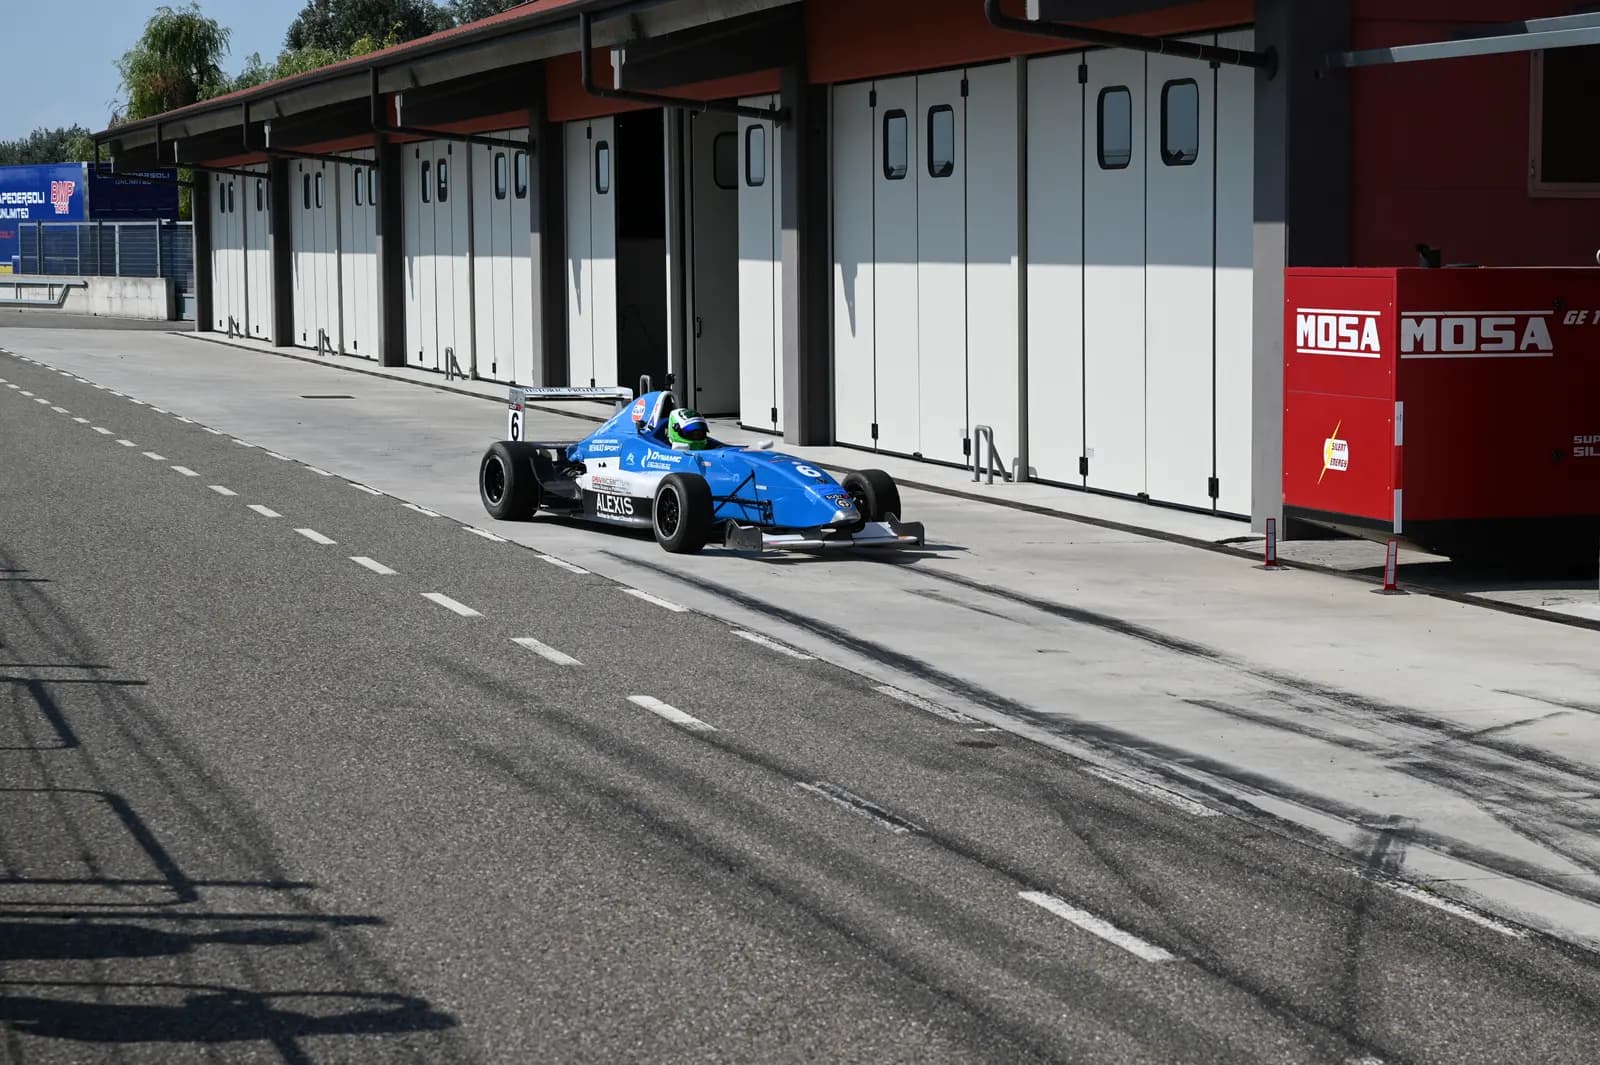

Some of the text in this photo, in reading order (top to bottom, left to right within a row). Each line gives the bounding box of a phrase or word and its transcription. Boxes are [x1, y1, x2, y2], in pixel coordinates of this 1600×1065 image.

[1563, 310, 1589, 325] GE
[1296, 314, 1381, 352] MOSA
[1401, 317, 1554, 352] MOSA
[511, 412, 519, 441] 6
[796, 465, 821, 478] 6
[596, 492, 634, 515] ALEXIS
